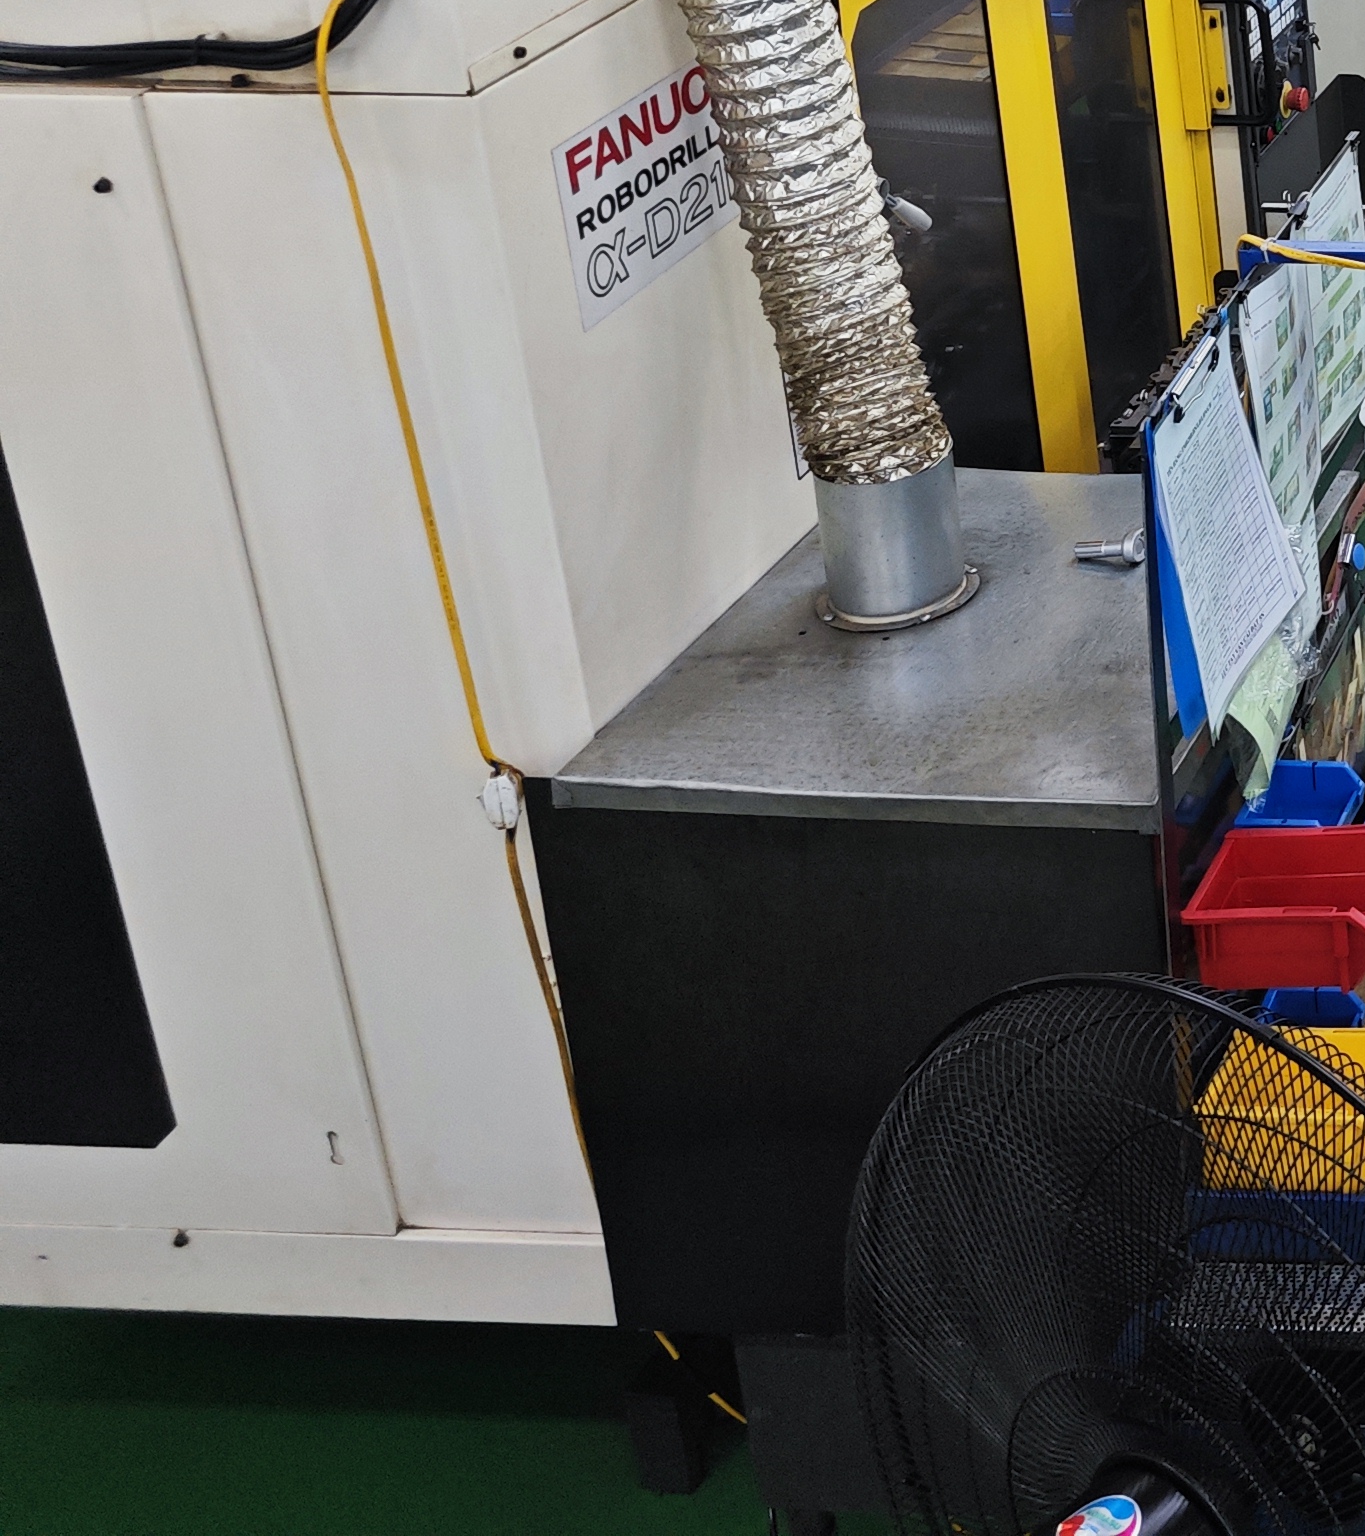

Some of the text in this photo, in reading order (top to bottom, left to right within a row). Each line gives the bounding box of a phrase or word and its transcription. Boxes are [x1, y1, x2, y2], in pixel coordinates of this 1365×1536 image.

[565, 65, 711, 195] FANUC
[576, 125, 720, 240] ROBODRILL
[587, 156, 733, 297] α-D21
